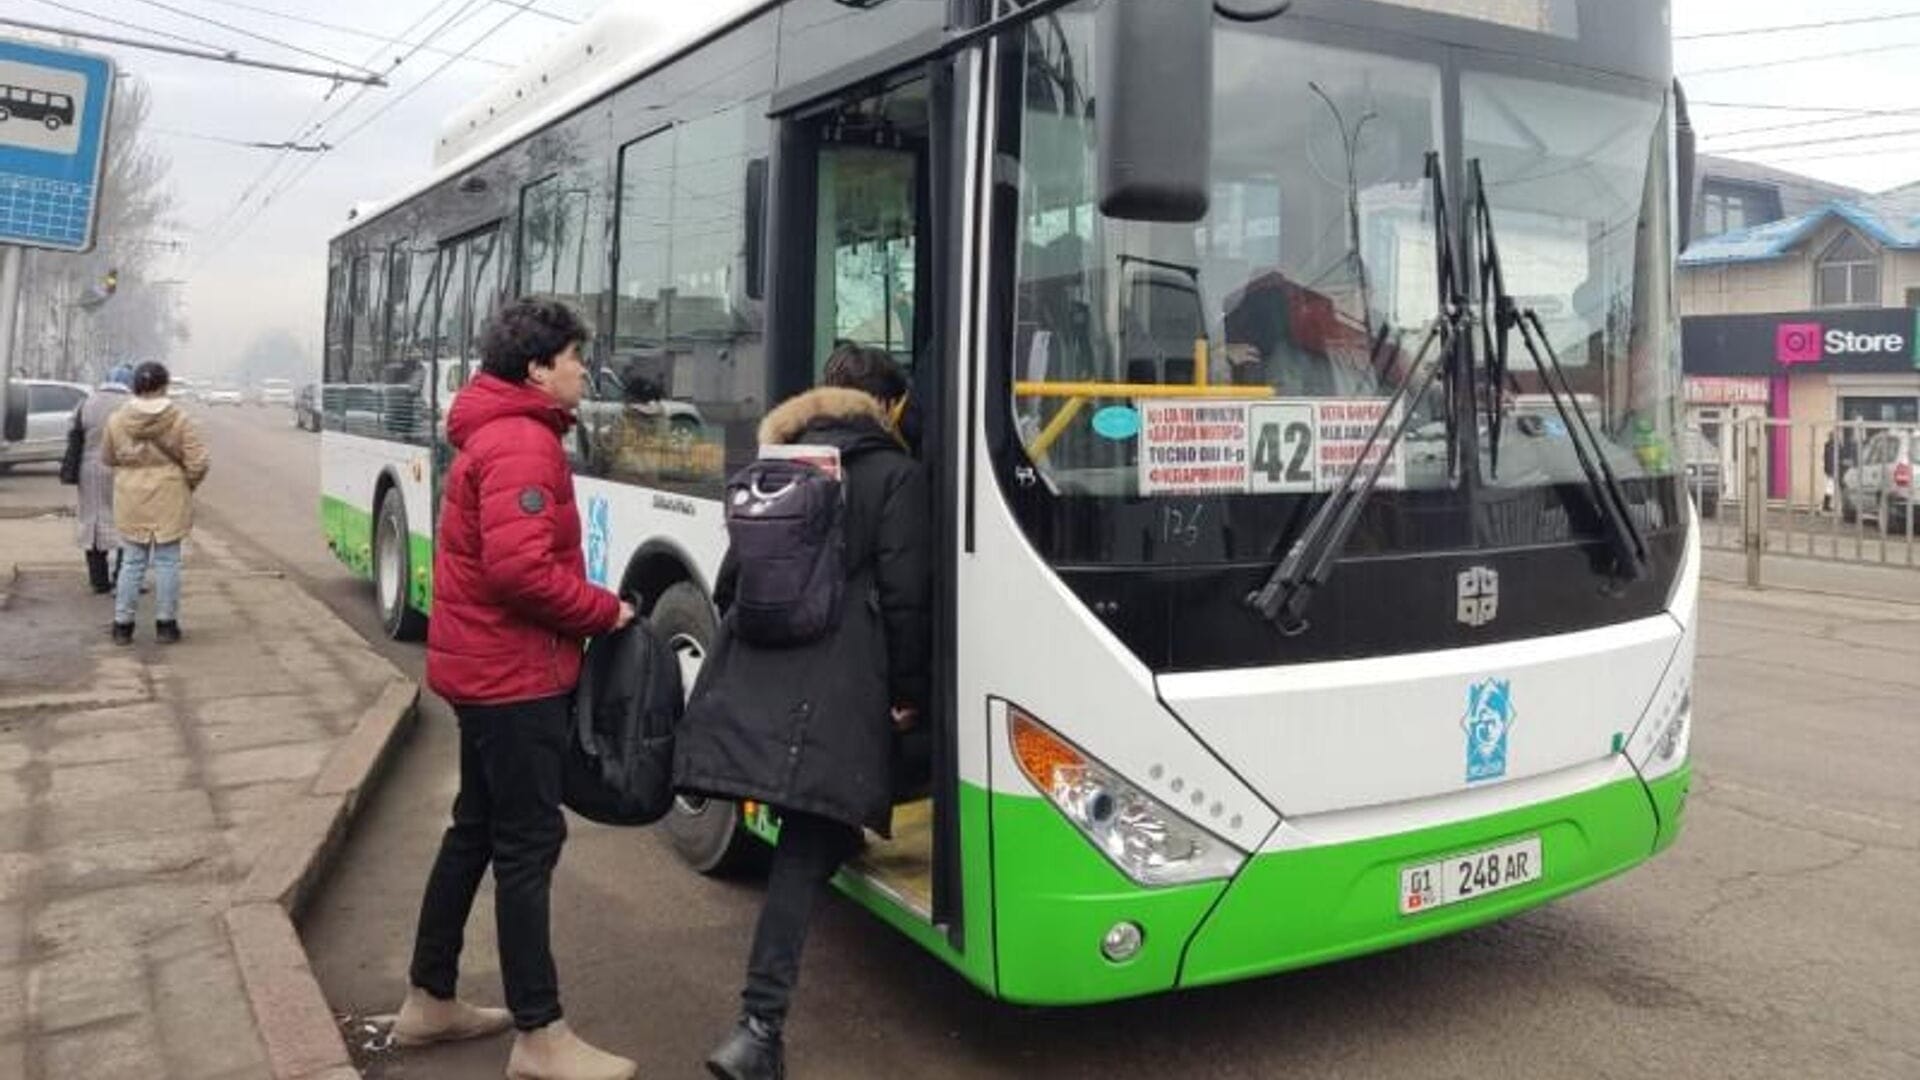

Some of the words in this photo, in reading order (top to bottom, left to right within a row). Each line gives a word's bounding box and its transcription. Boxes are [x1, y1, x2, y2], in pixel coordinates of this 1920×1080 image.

[1824, 329, 1904, 354] Store
[1253, 421, 1313, 483] 42
[1411, 869, 1432, 894] 01
[1459, 853, 1500, 895] 248
[1505, 851, 1529, 883] AR
